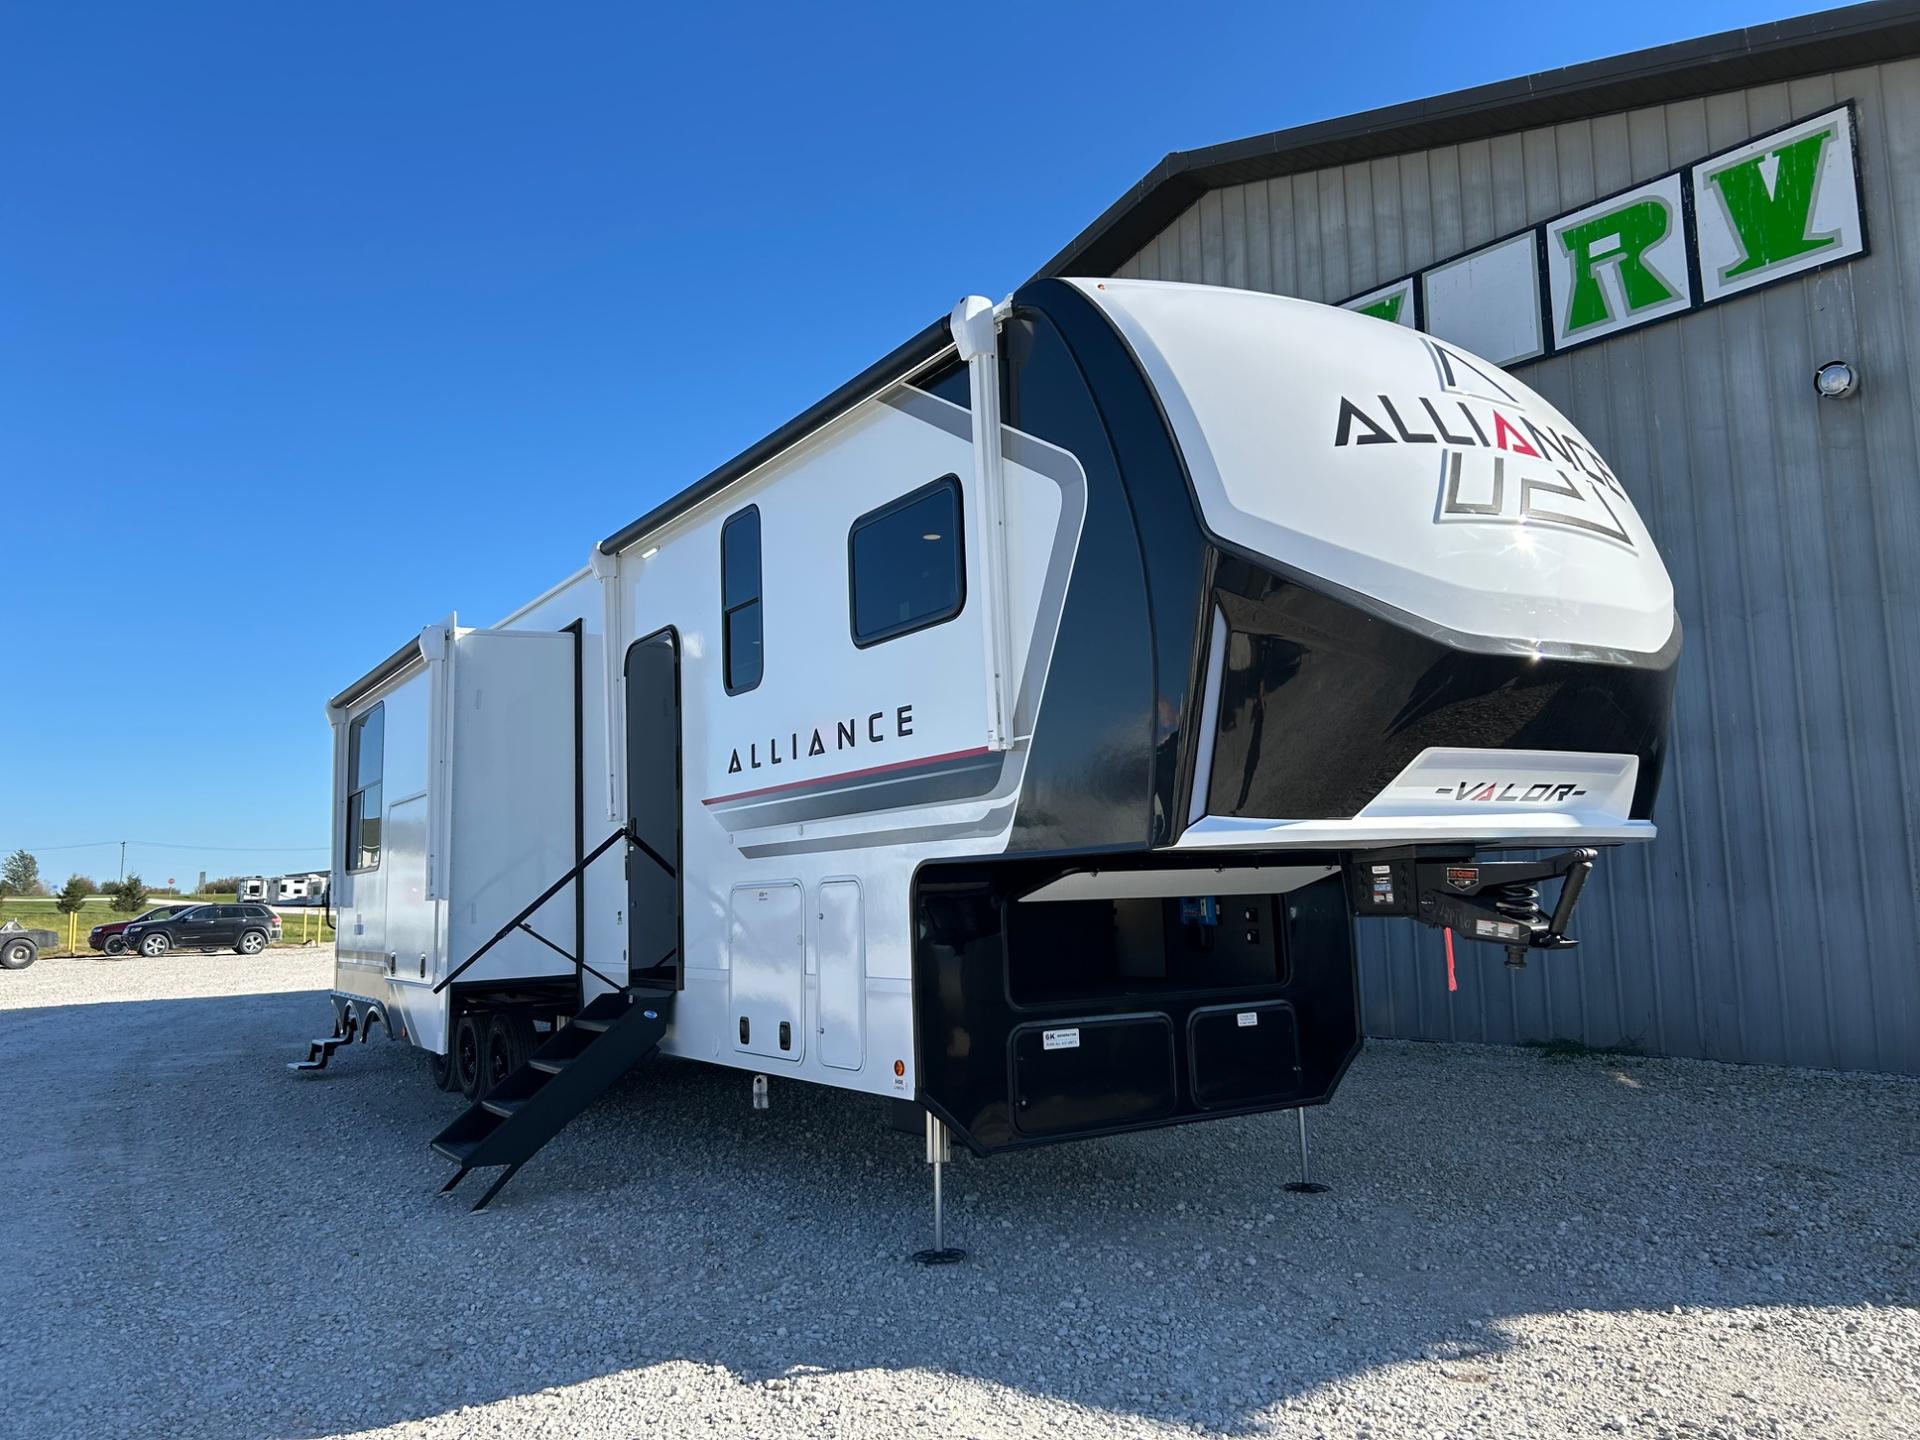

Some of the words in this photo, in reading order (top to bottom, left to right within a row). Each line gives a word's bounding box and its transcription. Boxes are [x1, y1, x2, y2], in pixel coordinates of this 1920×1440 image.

[1554, 121, 1842, 339] RV
[1335, 395, 1627, 503] ALLIANCE
[728, 704, 913, 774] ALLIANCE
